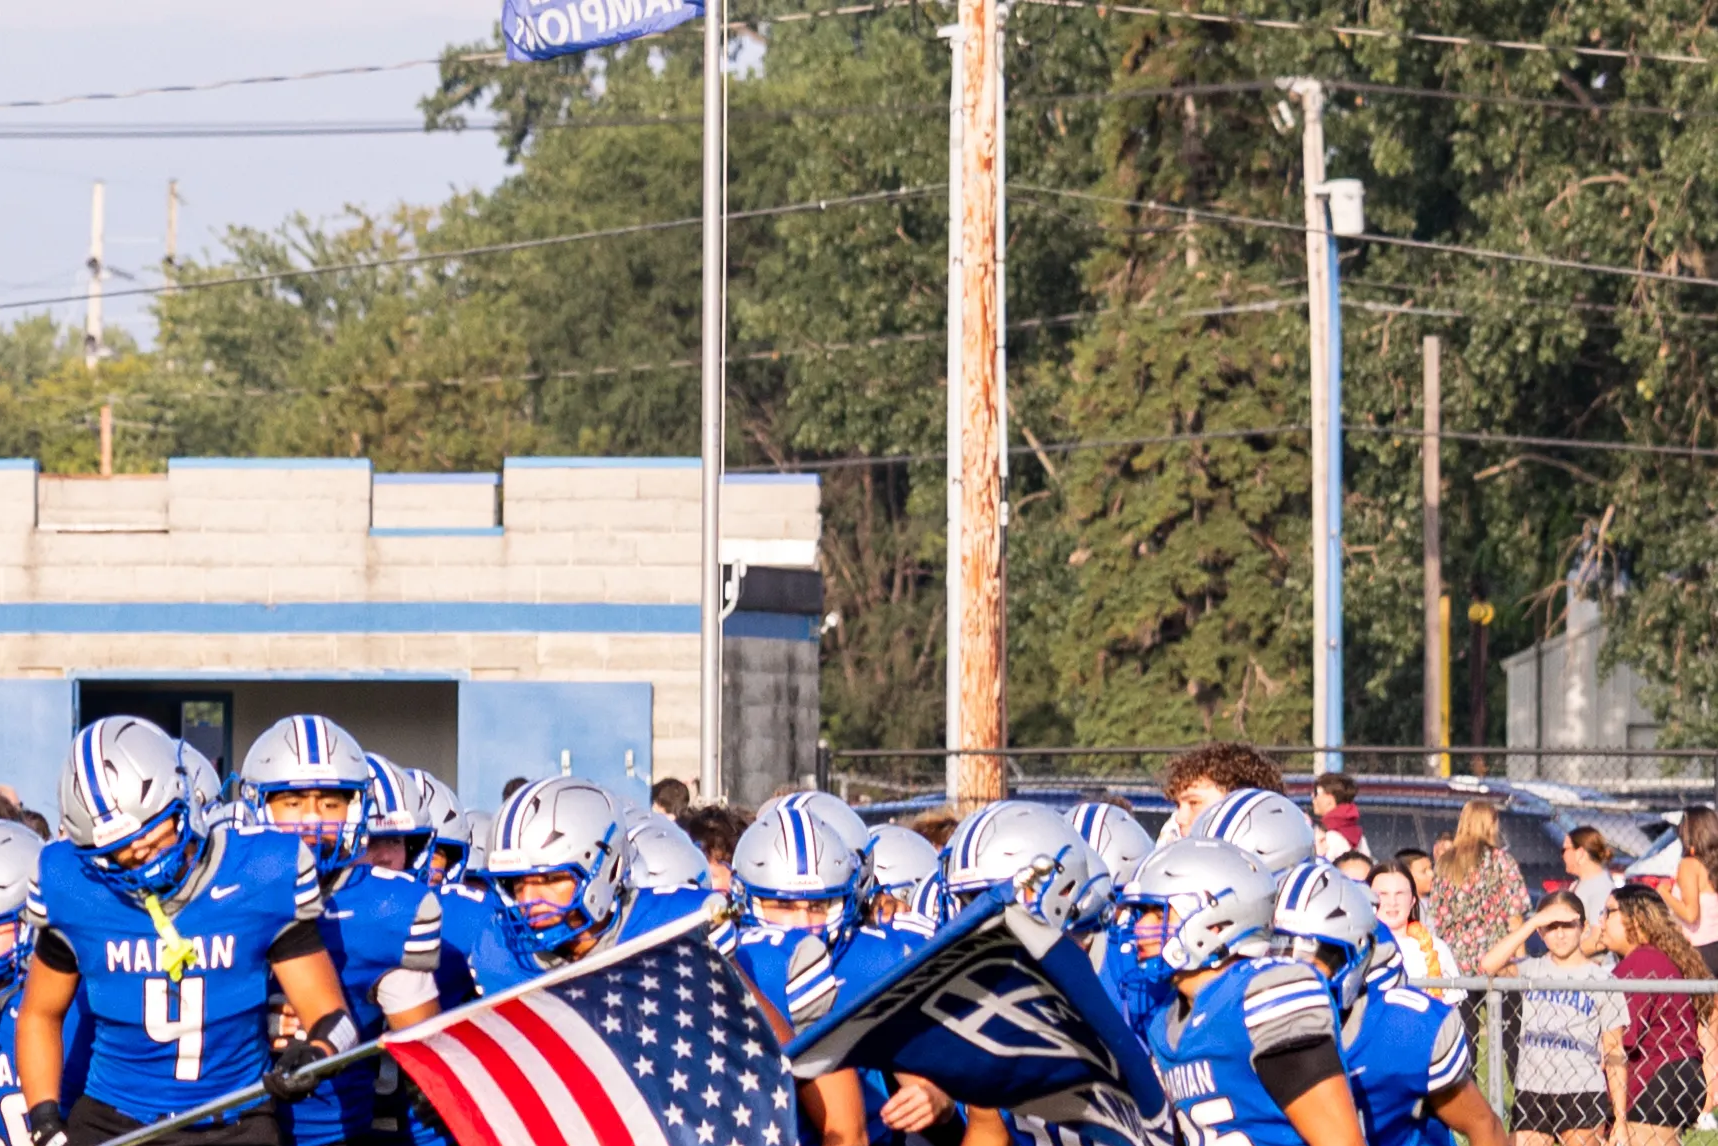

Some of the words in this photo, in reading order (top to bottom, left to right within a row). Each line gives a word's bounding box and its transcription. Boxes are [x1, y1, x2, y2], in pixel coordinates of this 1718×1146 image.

[105, 934, 235, 973] MAAN
[144, 976, 205, 1081] 4
[1163, 1060, 1216, 1100] ARIAN
